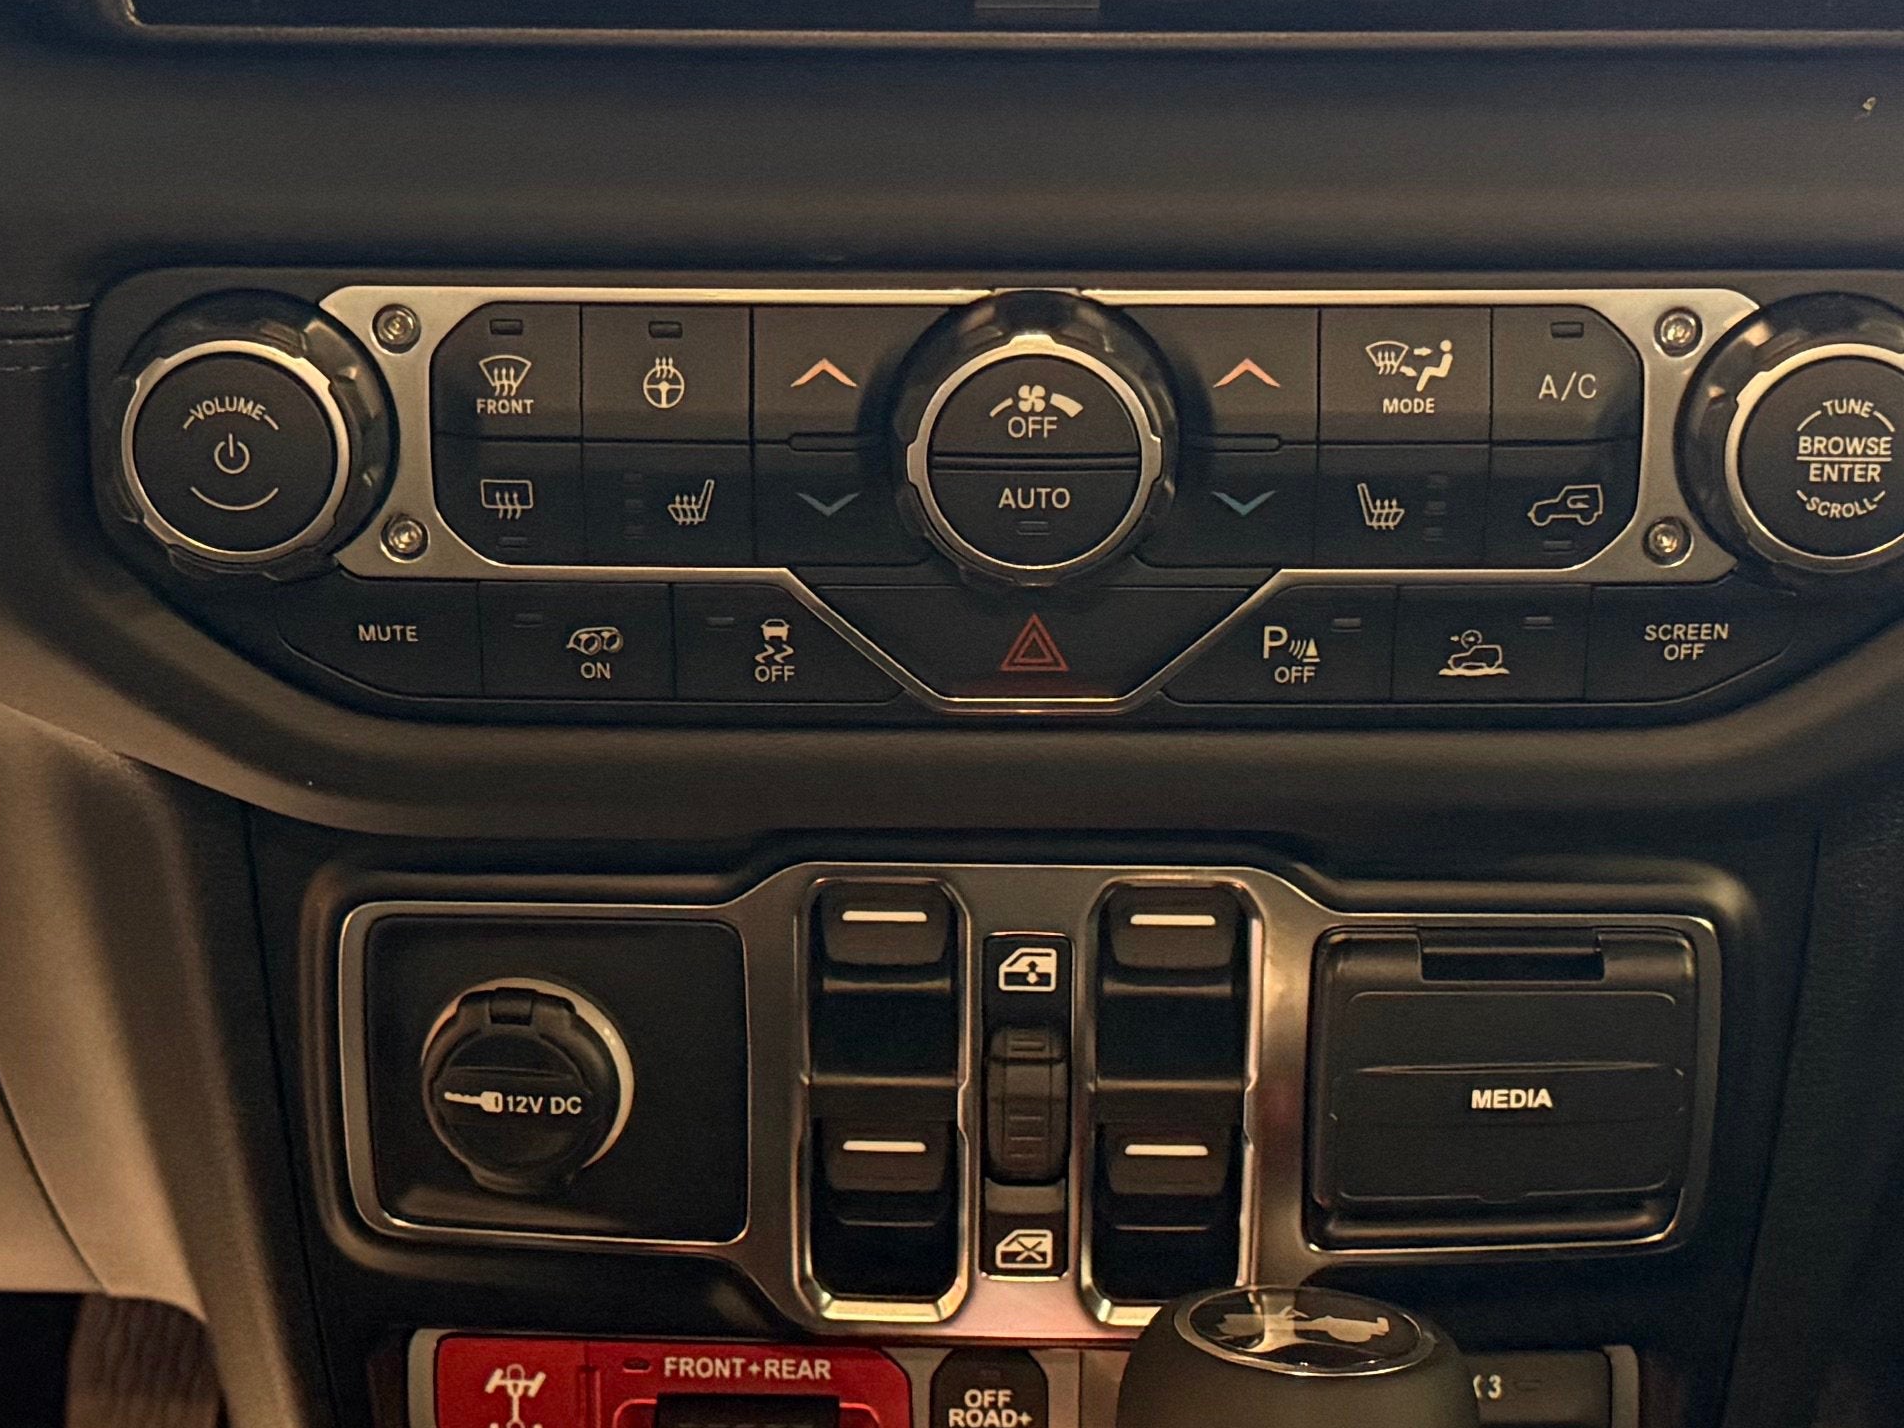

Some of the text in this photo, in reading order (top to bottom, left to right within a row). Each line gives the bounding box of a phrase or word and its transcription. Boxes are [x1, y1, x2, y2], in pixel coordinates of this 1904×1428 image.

[1537, 373, 1597, 401] A/C
[190, 396, 267, 422] VOLUME
[476, 398, 534, 415] FRONT
[1382, 398, 1436, 415] MODE
[1822, 399, 1875, 419] TUNE
[1007, 417, 1057, 439] OFF
[1797, 436, 1892, 456] BROWSE
[1809, 463, 1882, 483] ENTER
[998, 488, 1071, 509] AUTO
[1804, 495, 1879, 520] SCROLL
[358, 625, 418, 642] MUTE
[1644, 623, 1730, 642] SCREEN
[1263, 626, 1288, 660] P
[1664, 643, 1706, 661] OFF
[580, 663, 611, 680] ON
[754, 665, 795, 682] OFF
[1274, 667, 1316, 684] OFF
[505, 1095, 583, 1116] 12V DC
[1470, 1088, 1553, 1110] MEDIA
[663, 1356, 832, 1380] FRONT+REAR
[1487, 1374, 1503, 1400] 3
[964, 1389, 1012, 1409] OFF
[948, 1408, 1033, 1428] ROAD+
